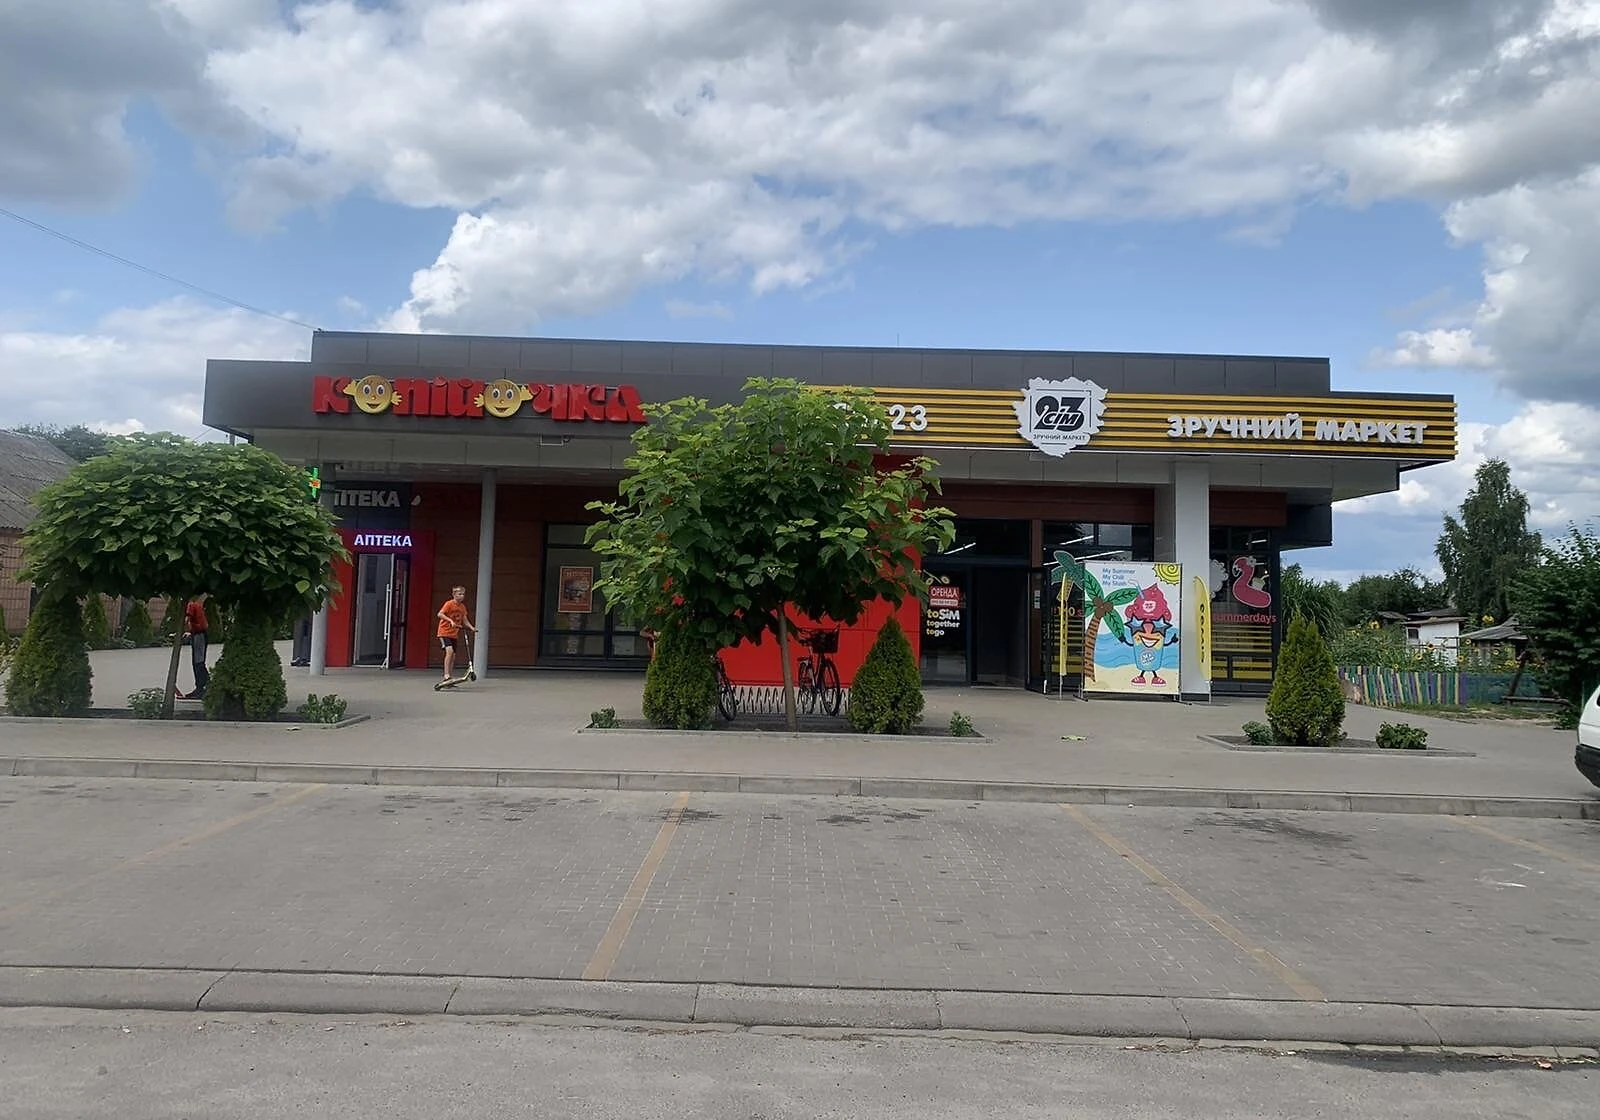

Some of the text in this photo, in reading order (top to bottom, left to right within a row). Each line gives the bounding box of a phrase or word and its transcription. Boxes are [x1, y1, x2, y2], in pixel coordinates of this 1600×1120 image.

[1167, 412, 1428, 444] ЗРУЧНИЙ МАРКЕТ
[333, 489, 401, 507] ПТЕКА
[354, 534, 412, 547] АПТЕКА
[930, 587, 959, 598] ОРЕНДА
